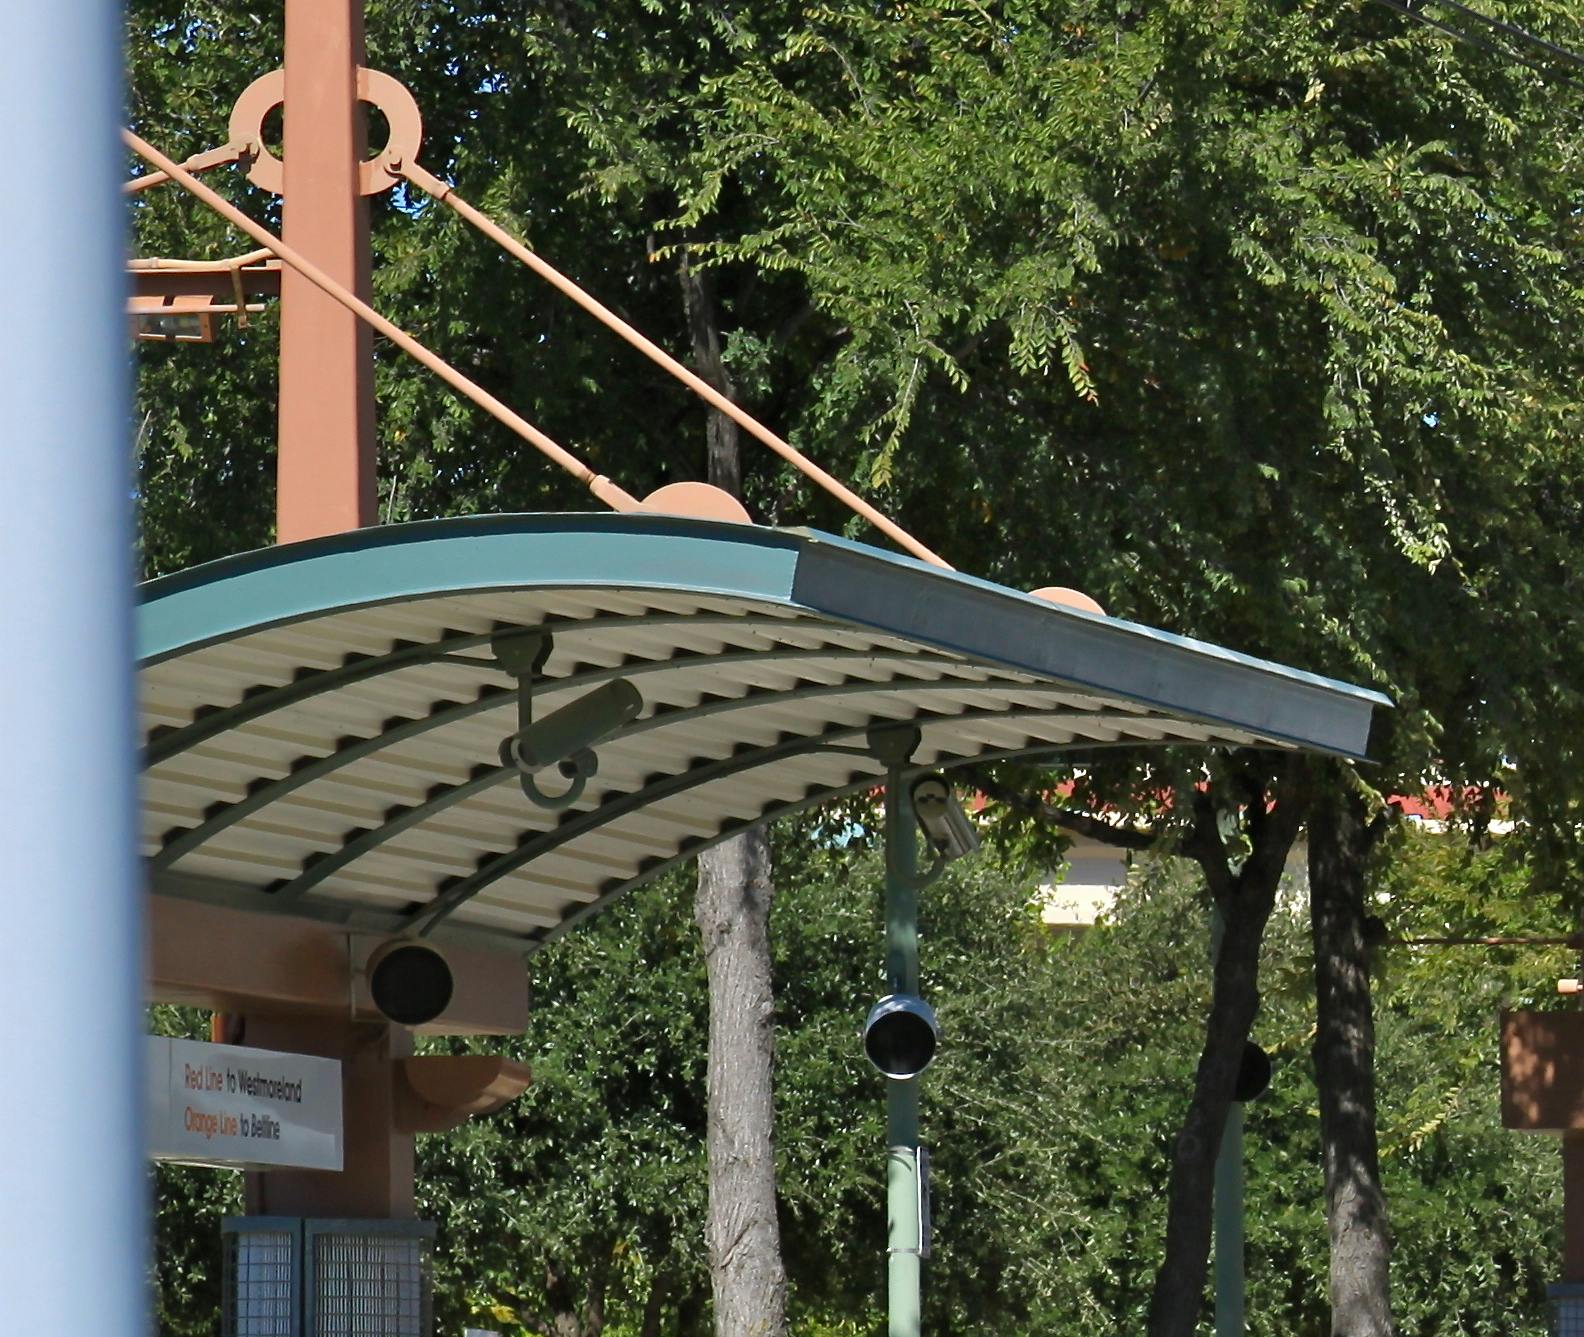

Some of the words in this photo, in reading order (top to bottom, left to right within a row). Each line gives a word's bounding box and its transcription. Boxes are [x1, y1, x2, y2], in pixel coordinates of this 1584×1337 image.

[185, 1063, 203, 1090] Red
[205, 1065, 223, 1092] Line
[227, 1067, 236, 1094] to
[238, 1069, 303, 1104] Westmoreland
[184, 1105, 218, 1140] Orange
[220, 1109, 237, 1137] Line
[240, 1113, 249, 1138] to
